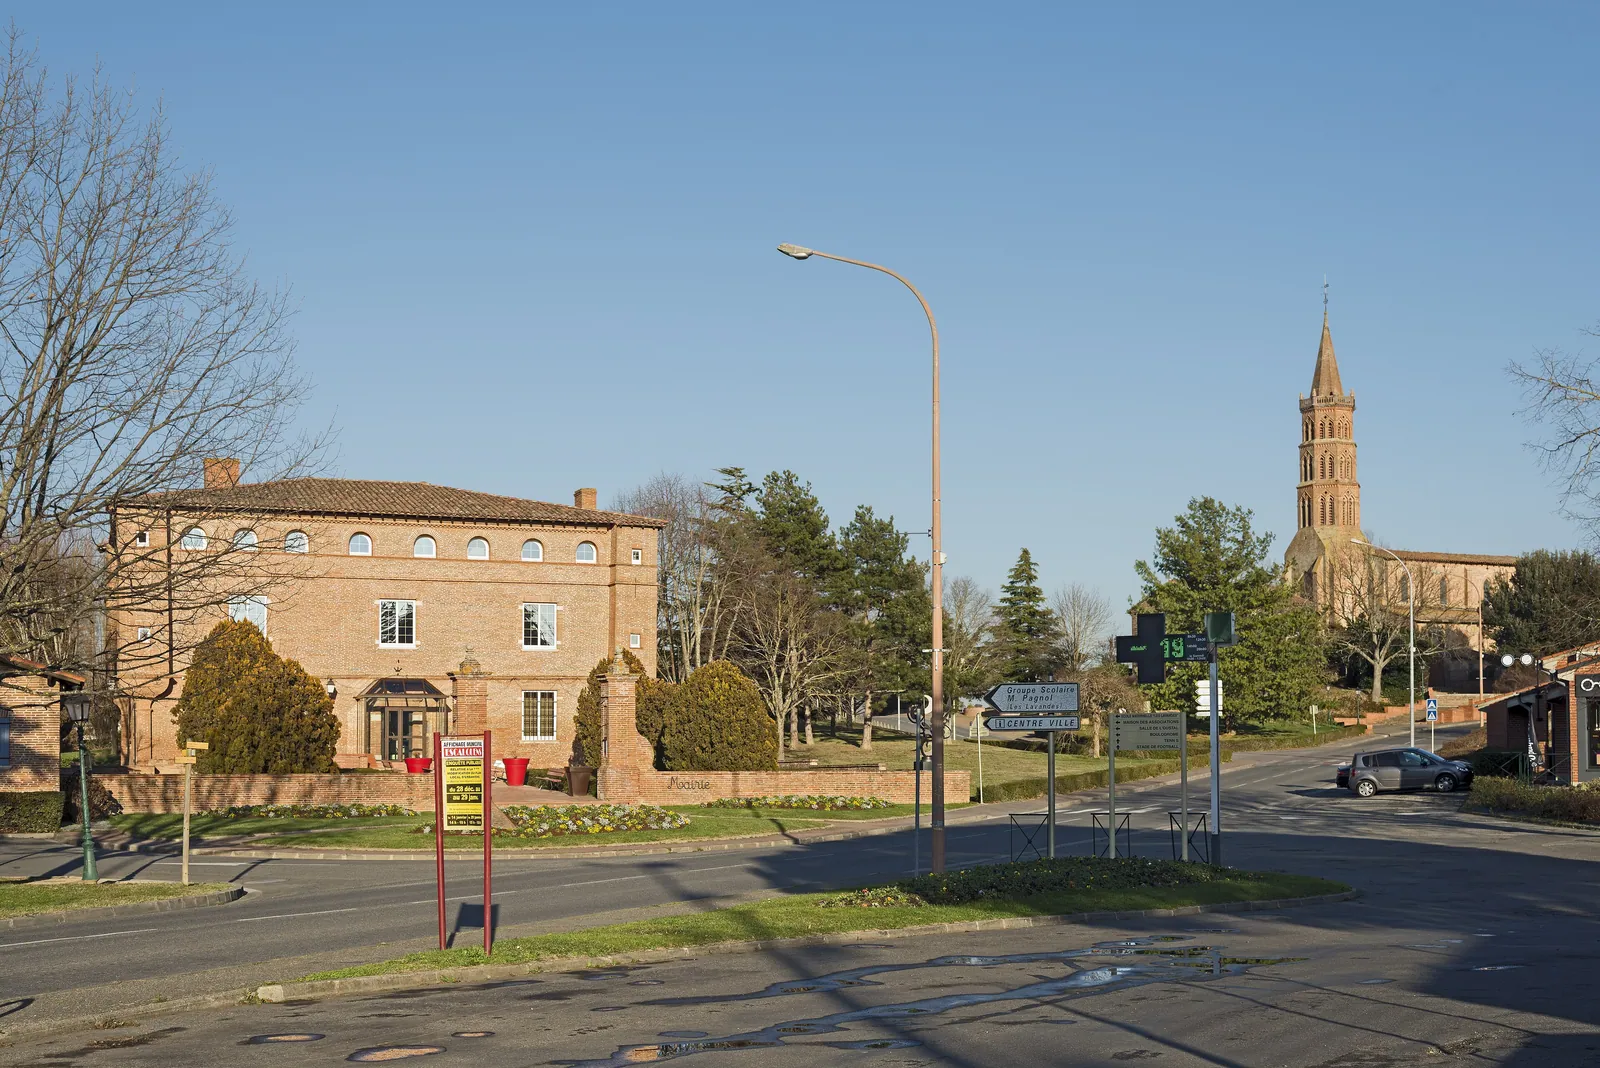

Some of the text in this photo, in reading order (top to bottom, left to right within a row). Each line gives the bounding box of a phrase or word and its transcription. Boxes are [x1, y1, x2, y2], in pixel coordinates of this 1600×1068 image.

[1160, 638, 1184, 658] 19
[1022, 694, 1053, 703] Pagnol
[667, 776, 710, 790] Mairie
